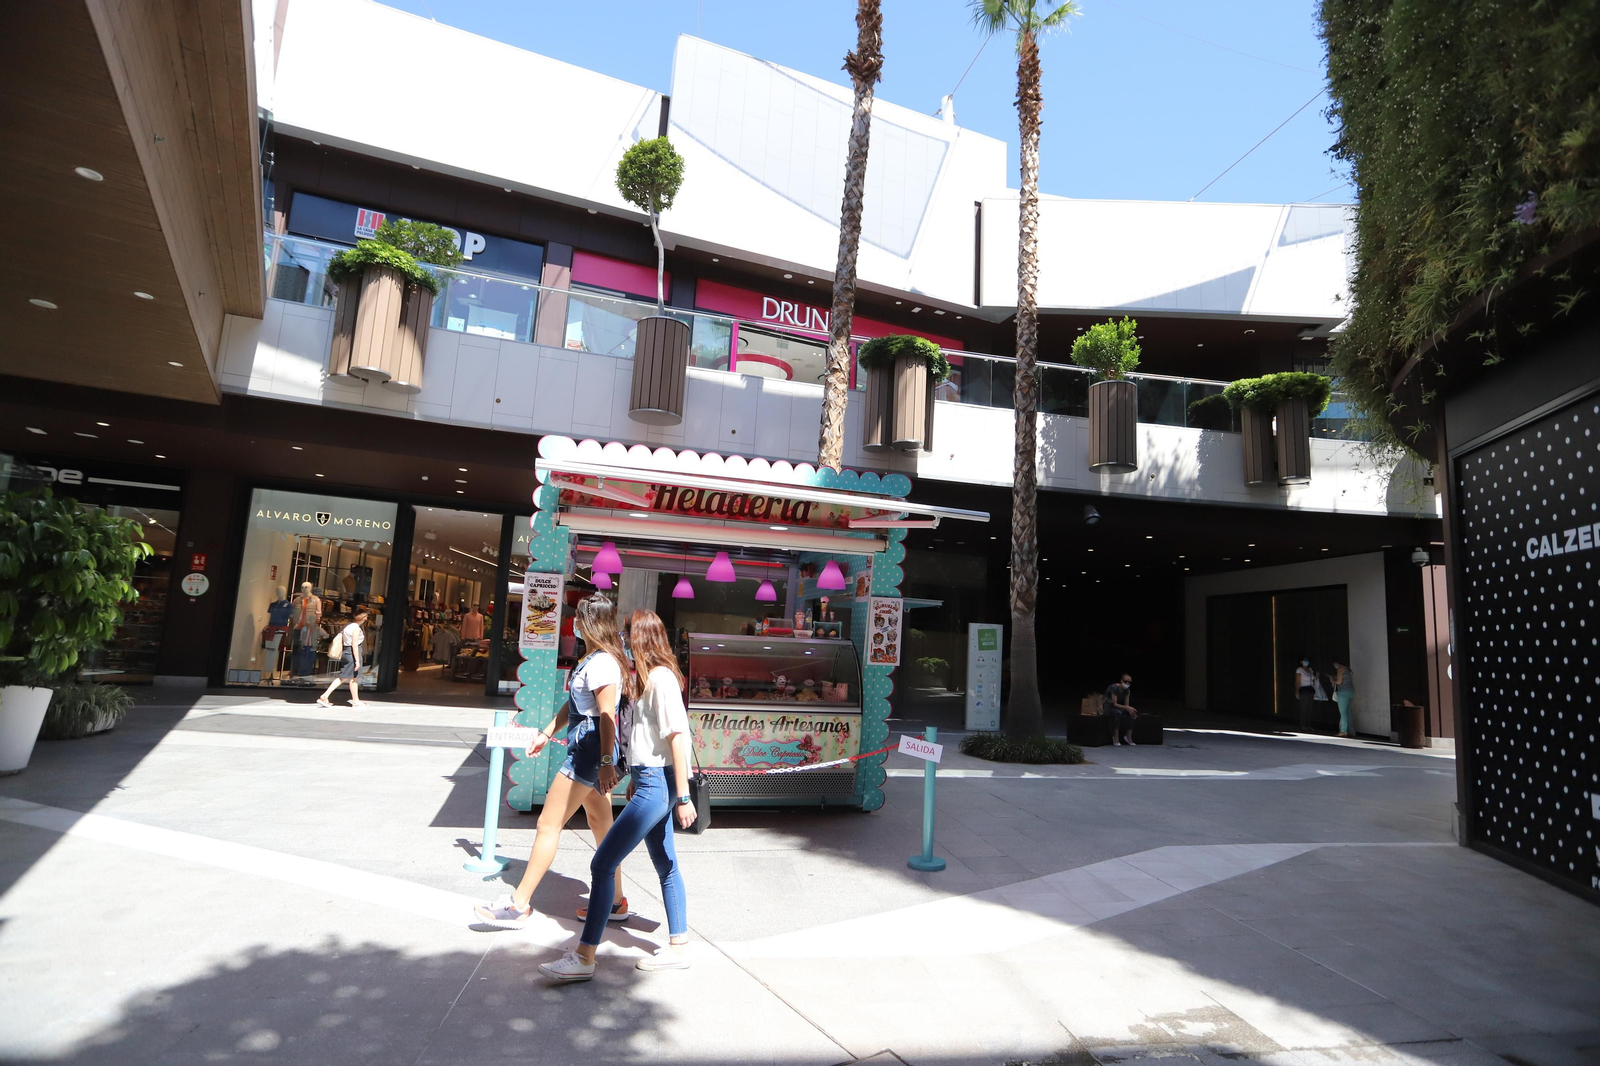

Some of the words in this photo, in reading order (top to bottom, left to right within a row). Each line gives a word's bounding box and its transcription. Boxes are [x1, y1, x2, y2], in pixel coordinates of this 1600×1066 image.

[761, 296, 833, 332] DRUN
[256, 509, 312, 523] ALVARO
[333, 517, 391, 530] MORENO
[700, 713, 765, 731] Helados
[770, 716, 850, 733] Artesanos
[489, 732, 535, 742] ENTRADA
[742, 746, 767, 757] Dulce
[905, 741, 936, 756] SALIDA
